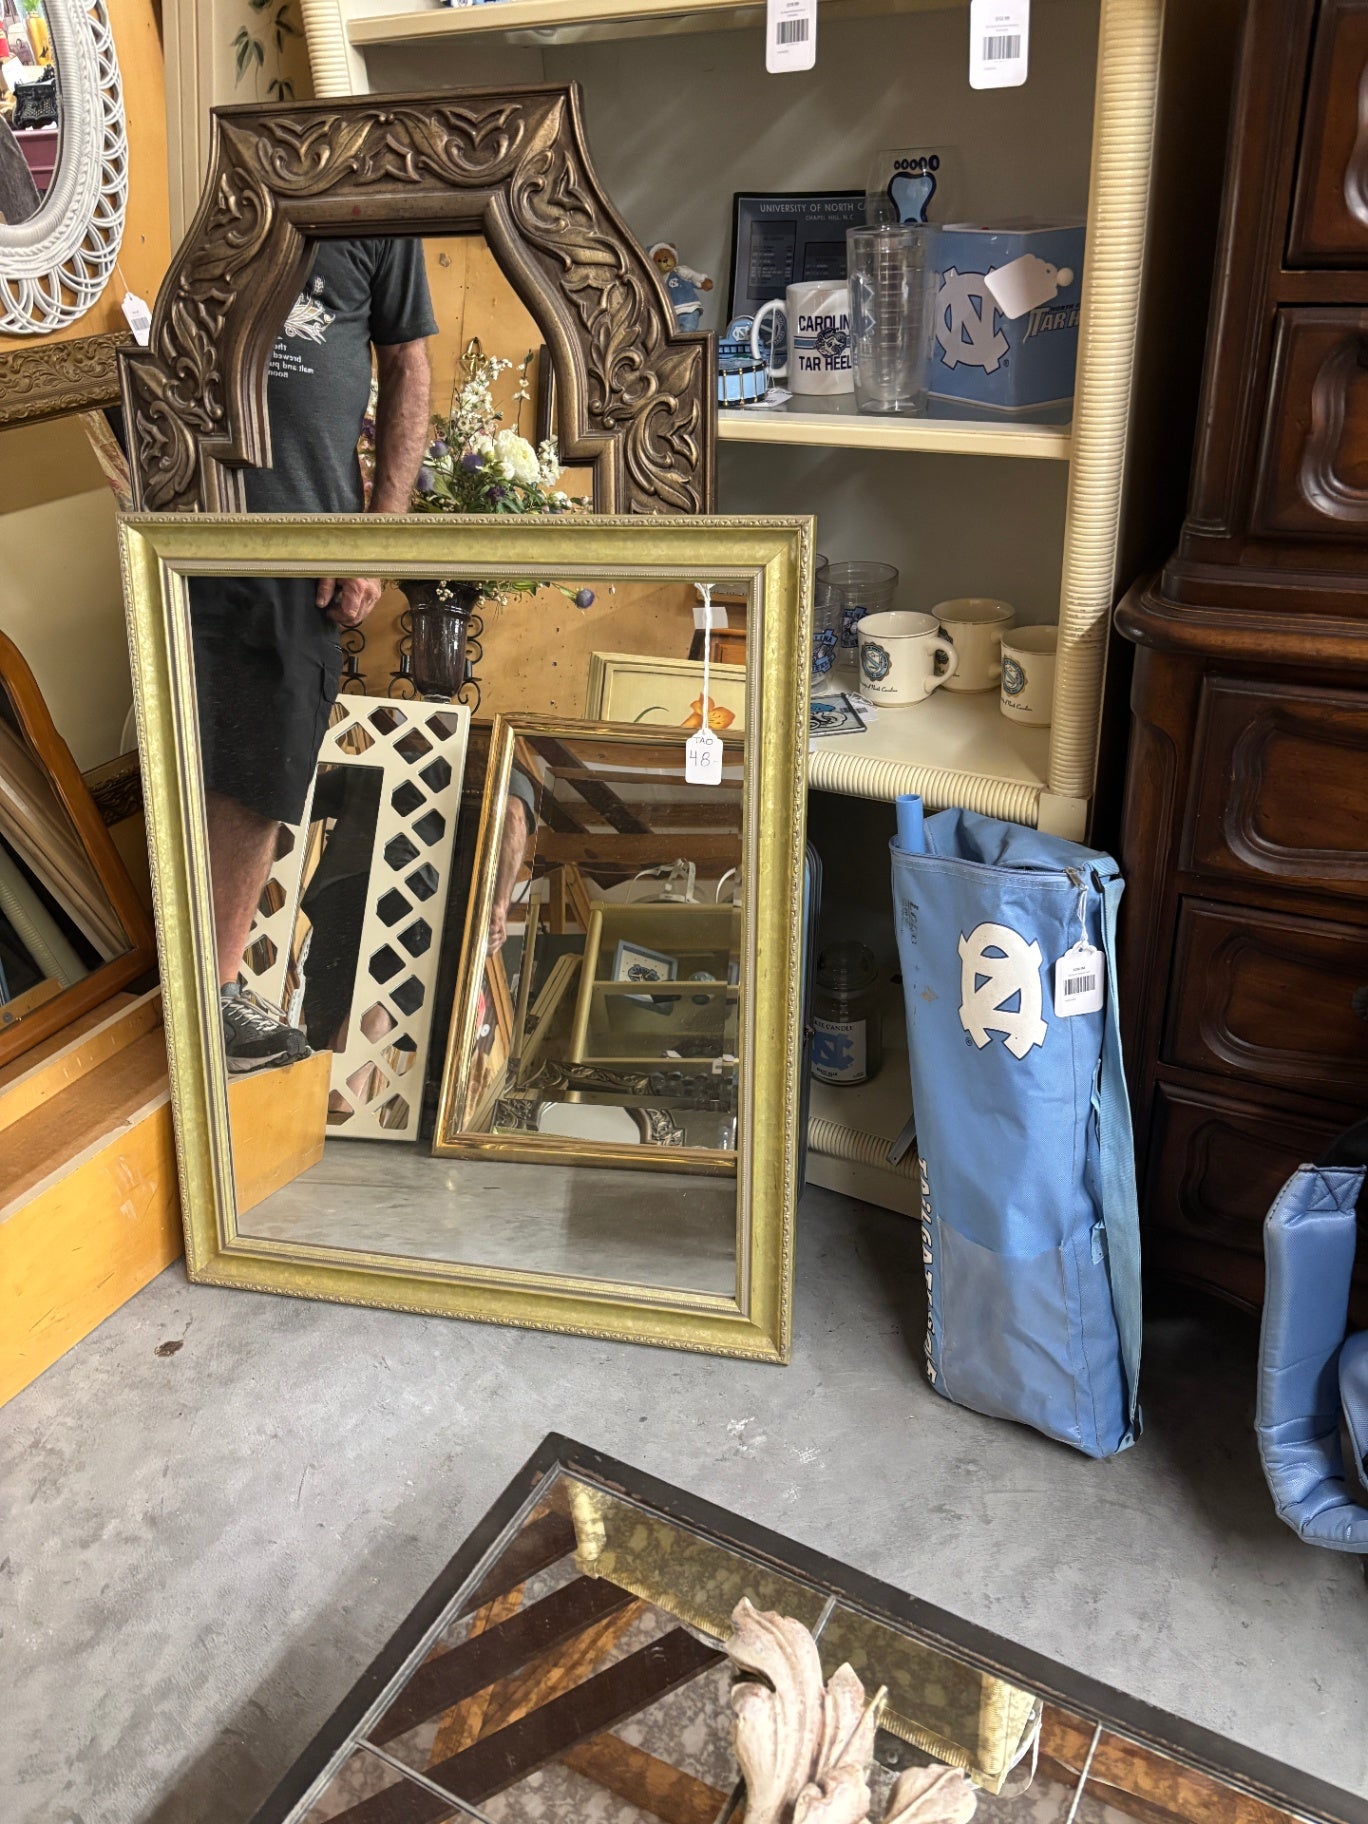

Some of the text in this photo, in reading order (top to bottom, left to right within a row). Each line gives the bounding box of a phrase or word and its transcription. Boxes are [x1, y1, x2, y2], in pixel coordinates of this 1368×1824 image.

[760, 203, 806, 213] UNIVERSITY
[809, 203, 821, 212] OF
[825, 203, 854, 212] NORTH
[798, 315, 850, 332] CAROLIN
[799, 356, 852, 371] TAR HEEL
